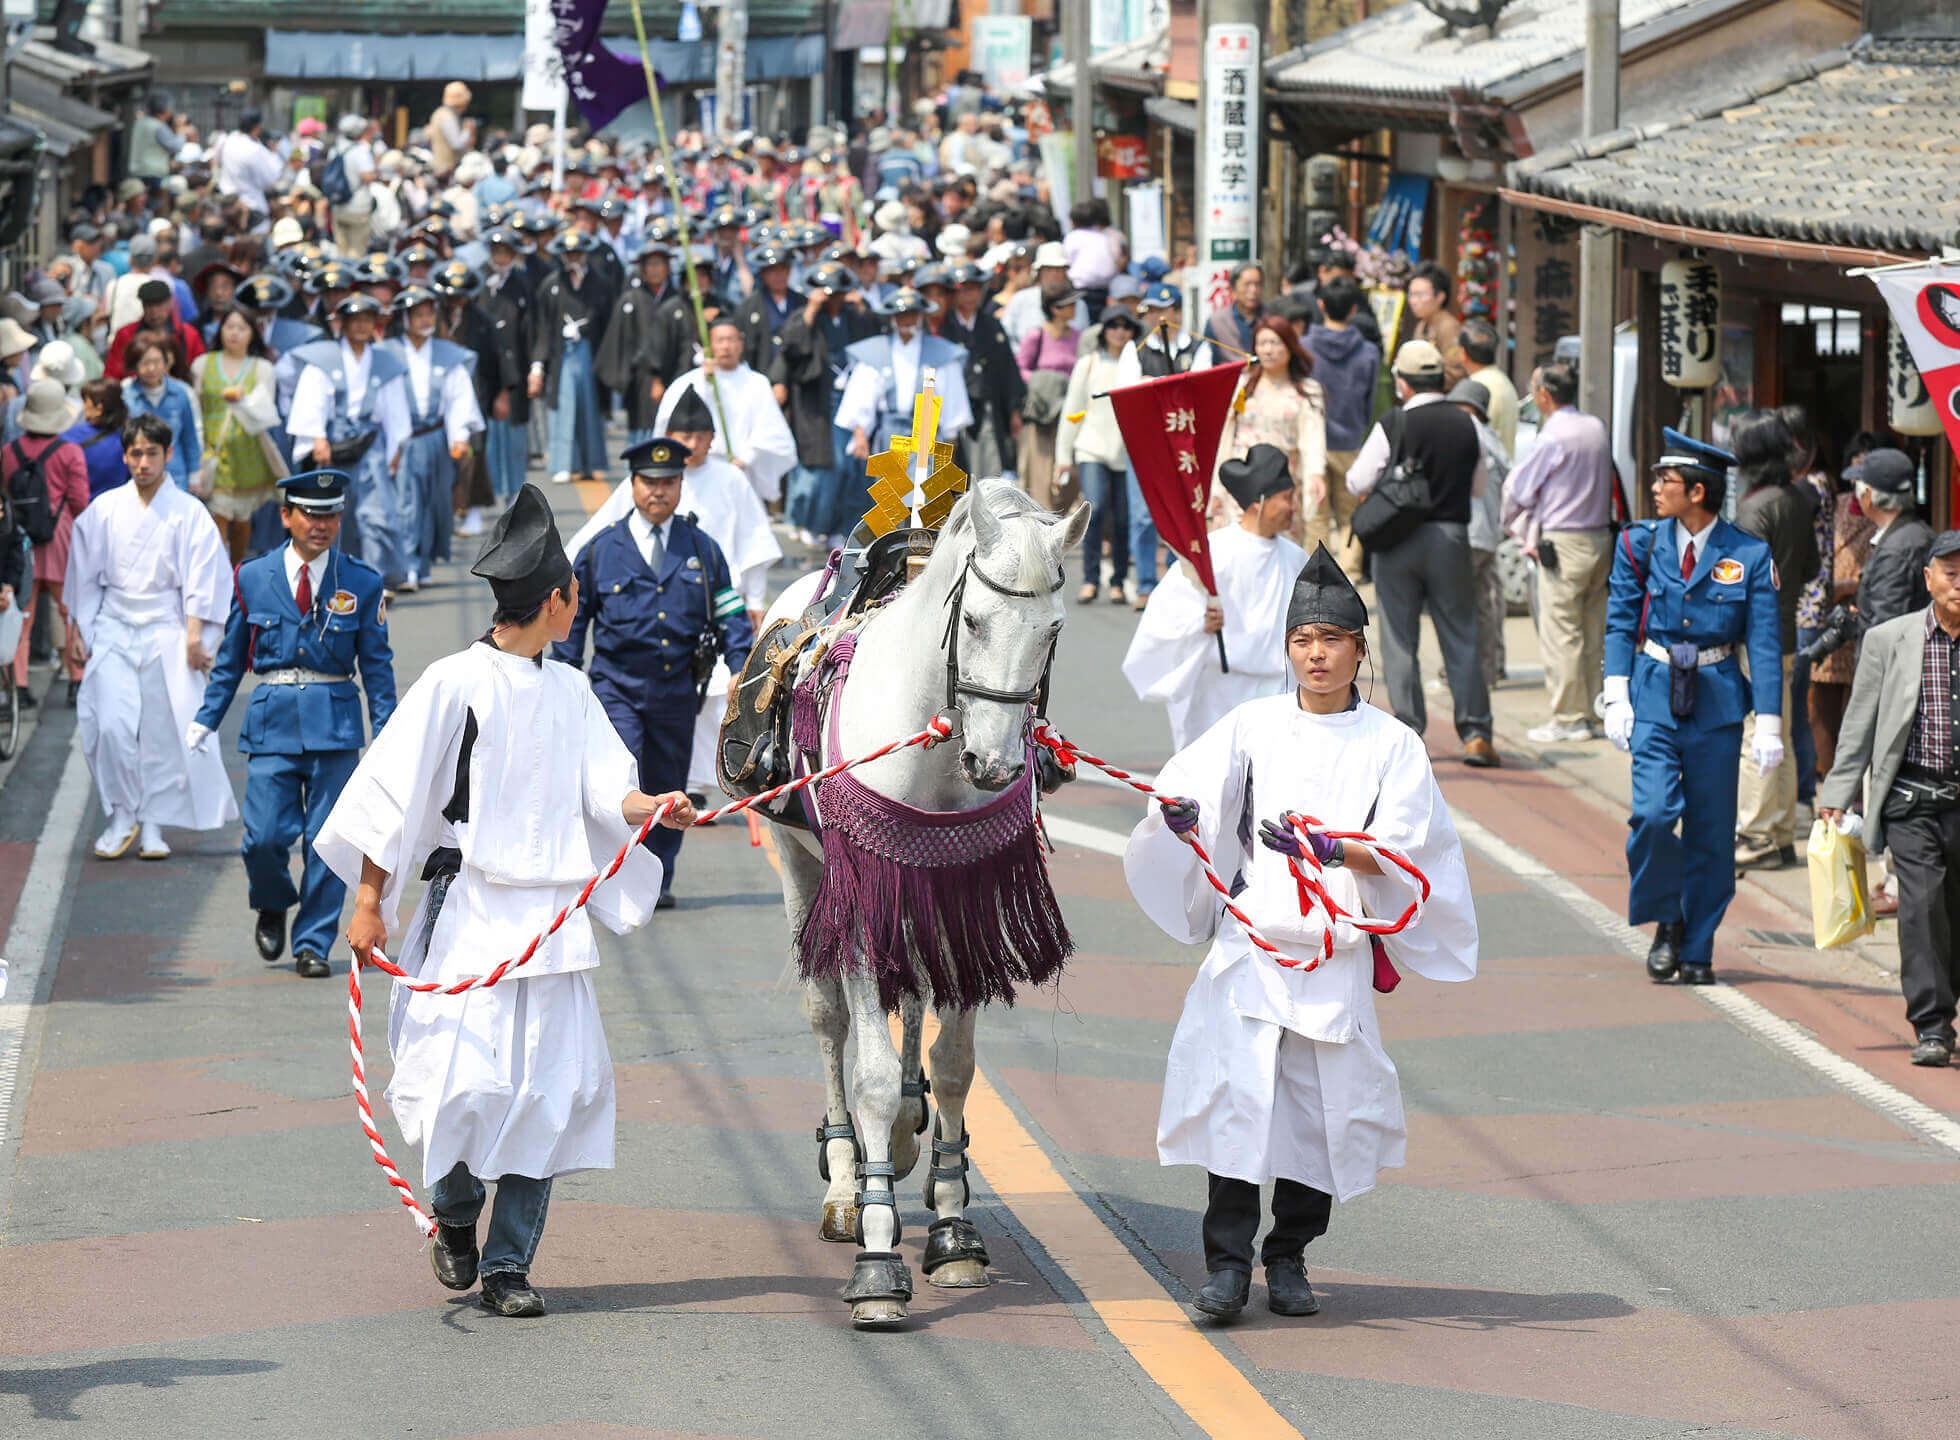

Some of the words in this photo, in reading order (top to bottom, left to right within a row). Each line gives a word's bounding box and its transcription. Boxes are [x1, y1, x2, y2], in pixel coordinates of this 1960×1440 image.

[1222, 68, 1248, 189] 酒蔵見学
[1684, 264, 1719, 363] 手搾り
